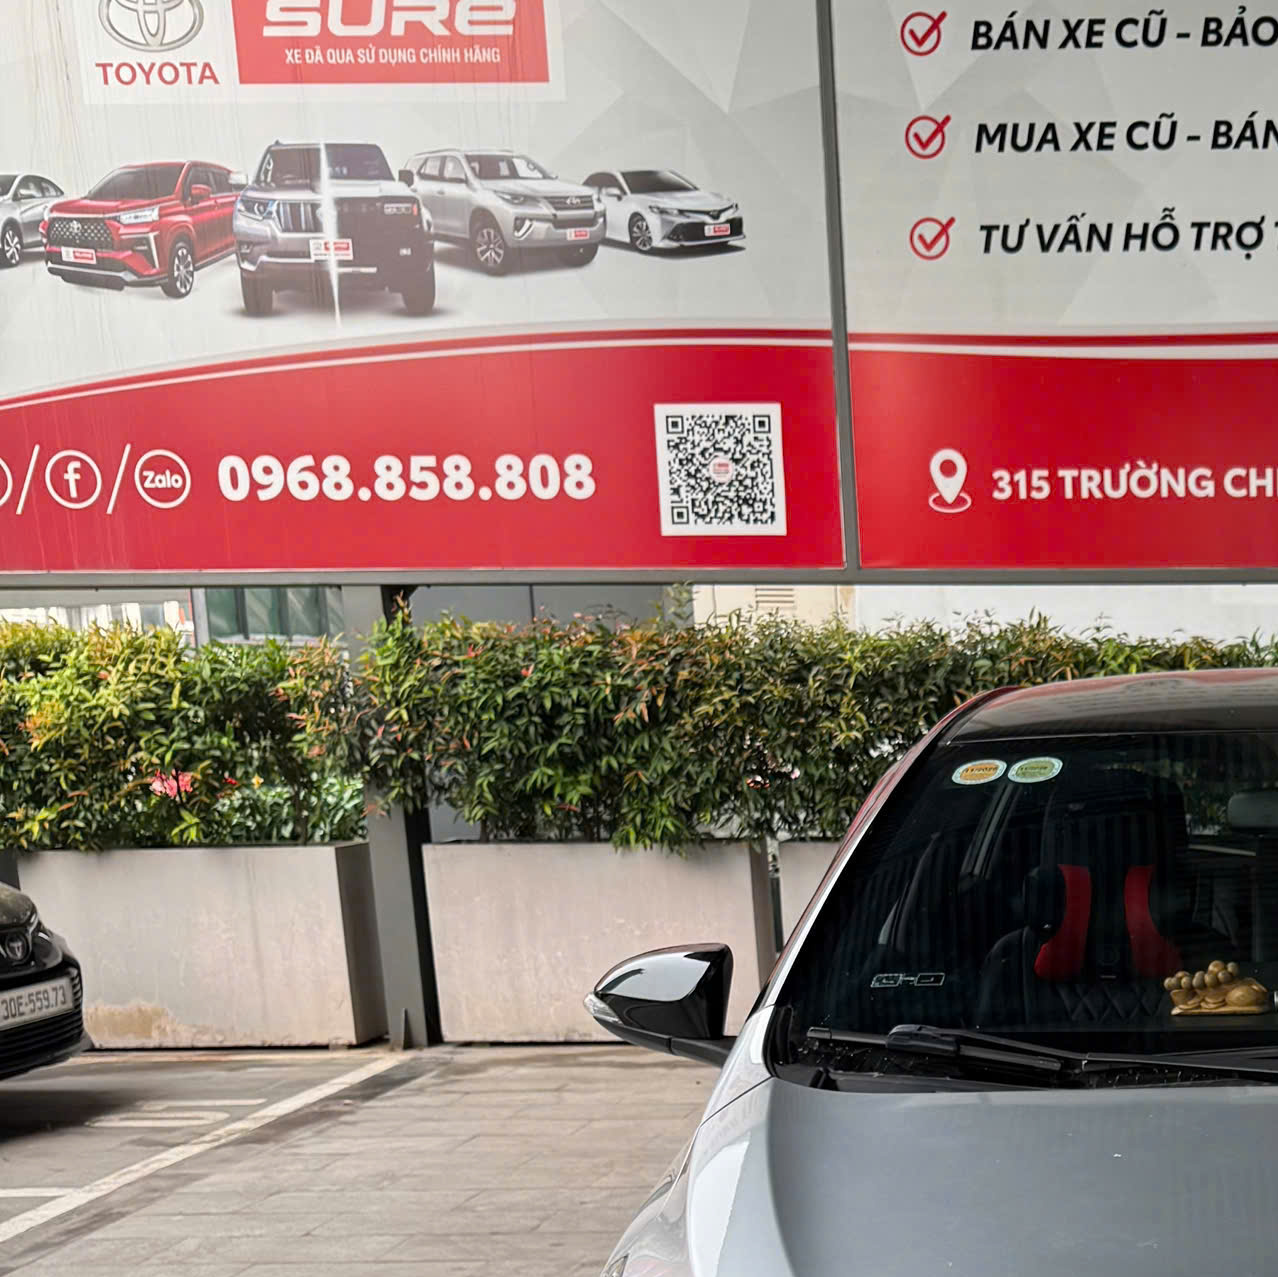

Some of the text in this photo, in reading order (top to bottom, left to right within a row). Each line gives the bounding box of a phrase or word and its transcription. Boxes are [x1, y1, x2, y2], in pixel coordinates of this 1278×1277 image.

[971, 11, 1050, 50] BÁN
[1059, 18, 1106, 49] XE
[1115, 9, 1168, 48] CŨ
[96, 62, 219, 86] TOYOTA
[285, 44, 500, 67] XE ĐÃ QUA SỬ DỤNG CHÍNH HÃNG
[974, 121, 1061, 153] MUA
[1070, 121, 1117, 152] XE
[1125, 112, 1179, 151] CŨ
[979, 218, 1030, 254] TƯ
[1035, 213, 1113, 253] VẤN
[1122, 207, 1181, 252] HỖ
[1190, 215, 1266, 260] TRỢ
[142, 468, 184, 490] Zalo
[217, 453, 596, 501] 0968.858.808
[992, 468, 1051, 501] 315
[1058, 458, 1213, 499] TRƯỜNG
[2, 985, 67, 1020] 30E-559.73
